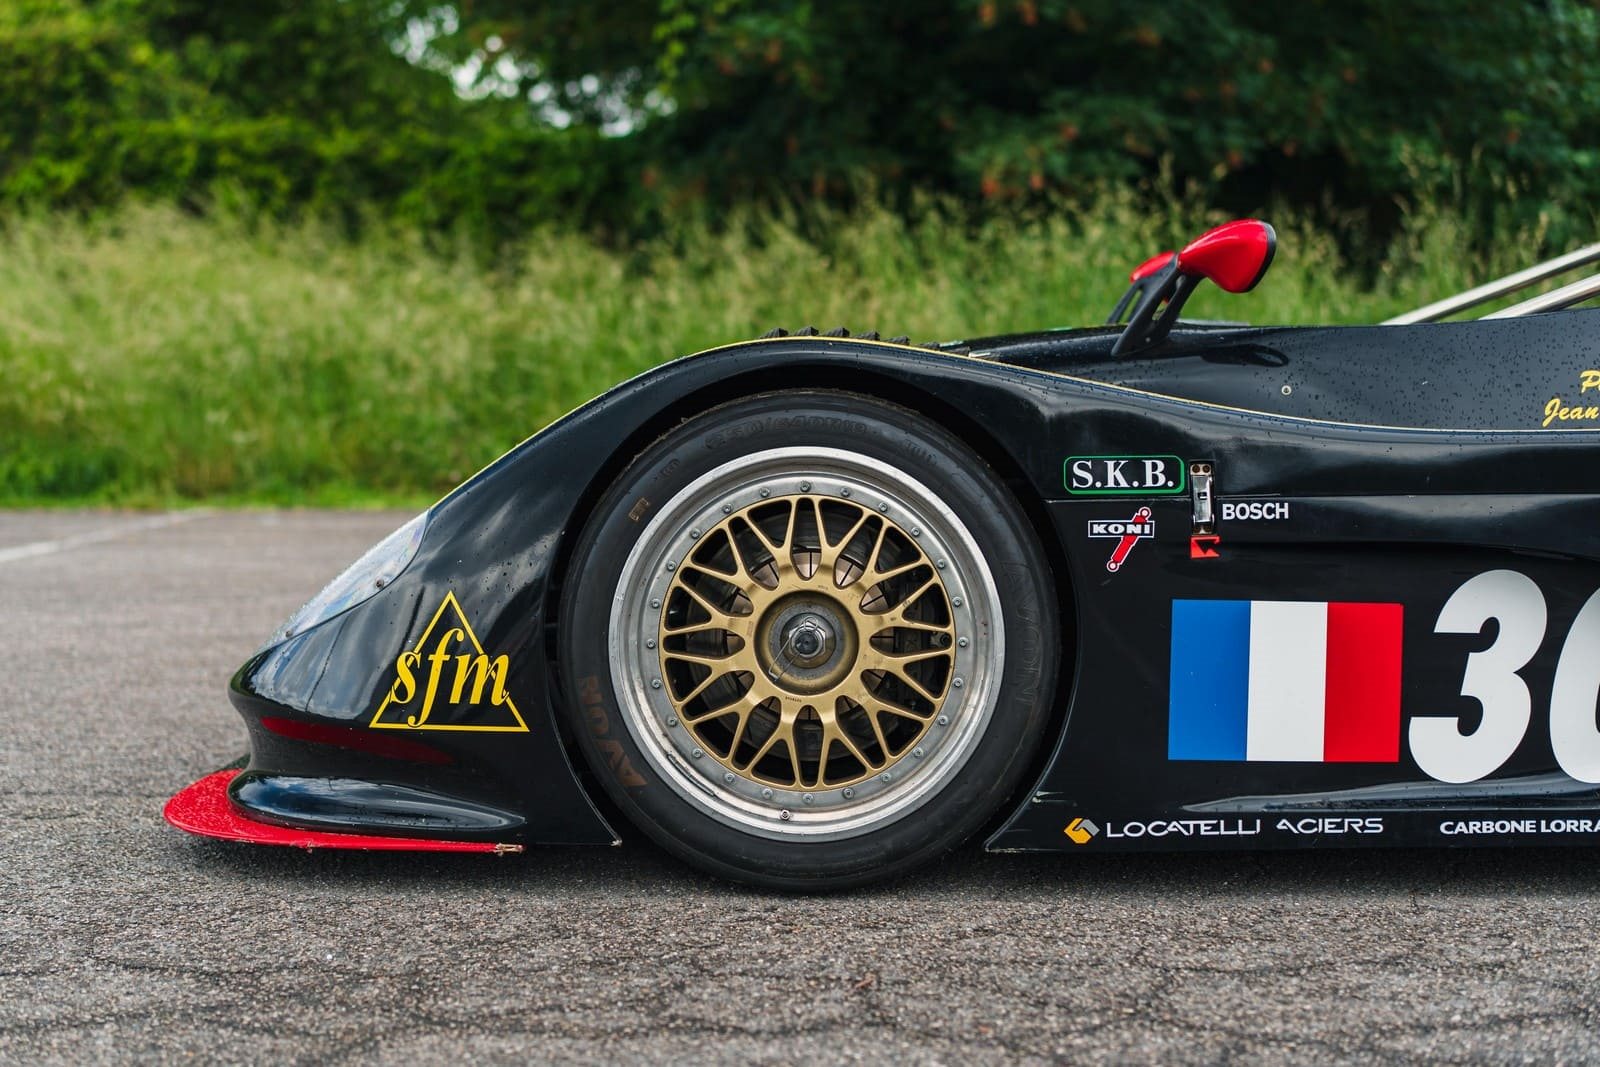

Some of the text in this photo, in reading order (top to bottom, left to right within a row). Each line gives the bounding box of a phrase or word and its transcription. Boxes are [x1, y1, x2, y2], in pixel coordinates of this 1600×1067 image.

[1580, 370, 1600, 393] P
[1542, 398, 1600, 427] Jean
[1072, 459, 1174, 488] S.K.B.
[1222, 502, 1289, 520] BOSCH
[1092, 524, 1150, 534] KONI
[389, 627, 509, 728] sfm
[1105, 817, 1383, 838] LOCATELLI ACIERS
[1439, 820, 1537, 834] CARBONE
